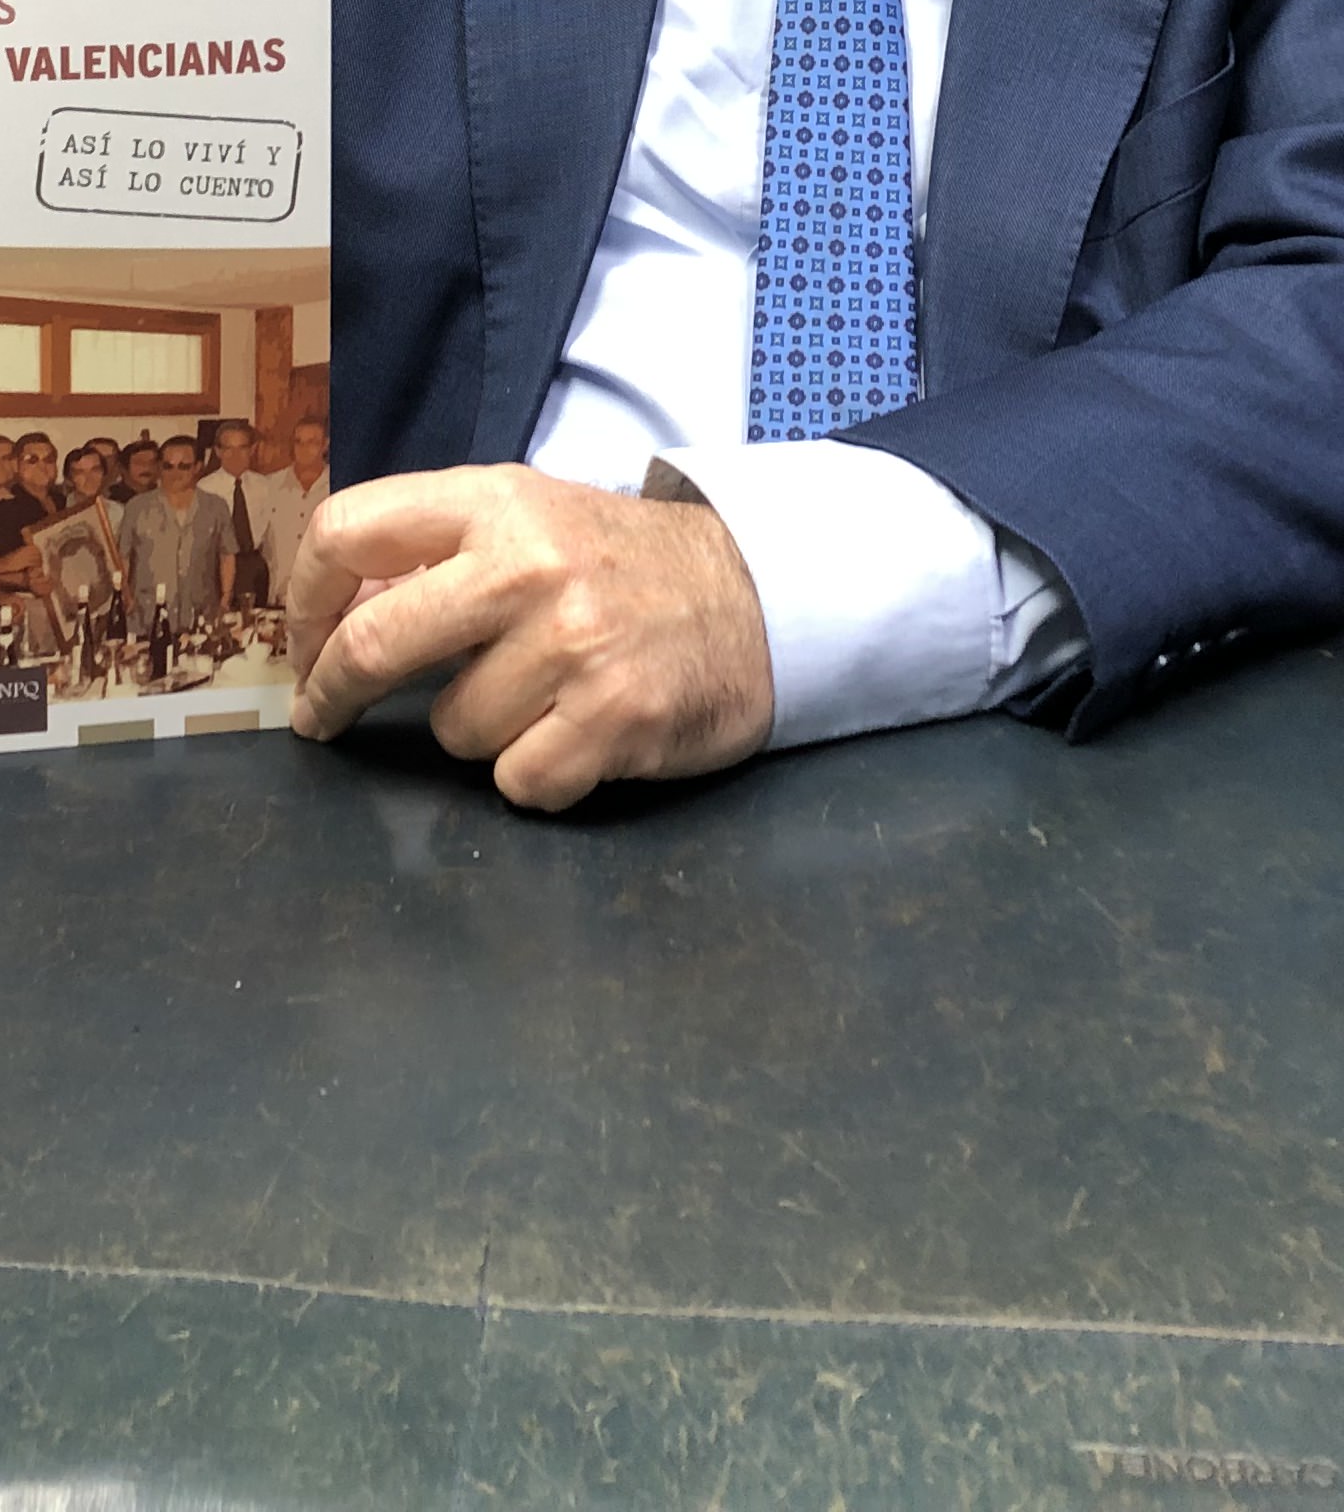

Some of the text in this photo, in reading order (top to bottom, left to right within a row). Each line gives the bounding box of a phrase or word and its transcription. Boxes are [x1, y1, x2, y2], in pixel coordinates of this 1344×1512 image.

[6, 37, 286, 82] VALENCIANAS
[62, 131, 282, 167] ASÍ LO VIVÍ Y
[58, 164, 274, 200] ASÍ LO CUENTO
